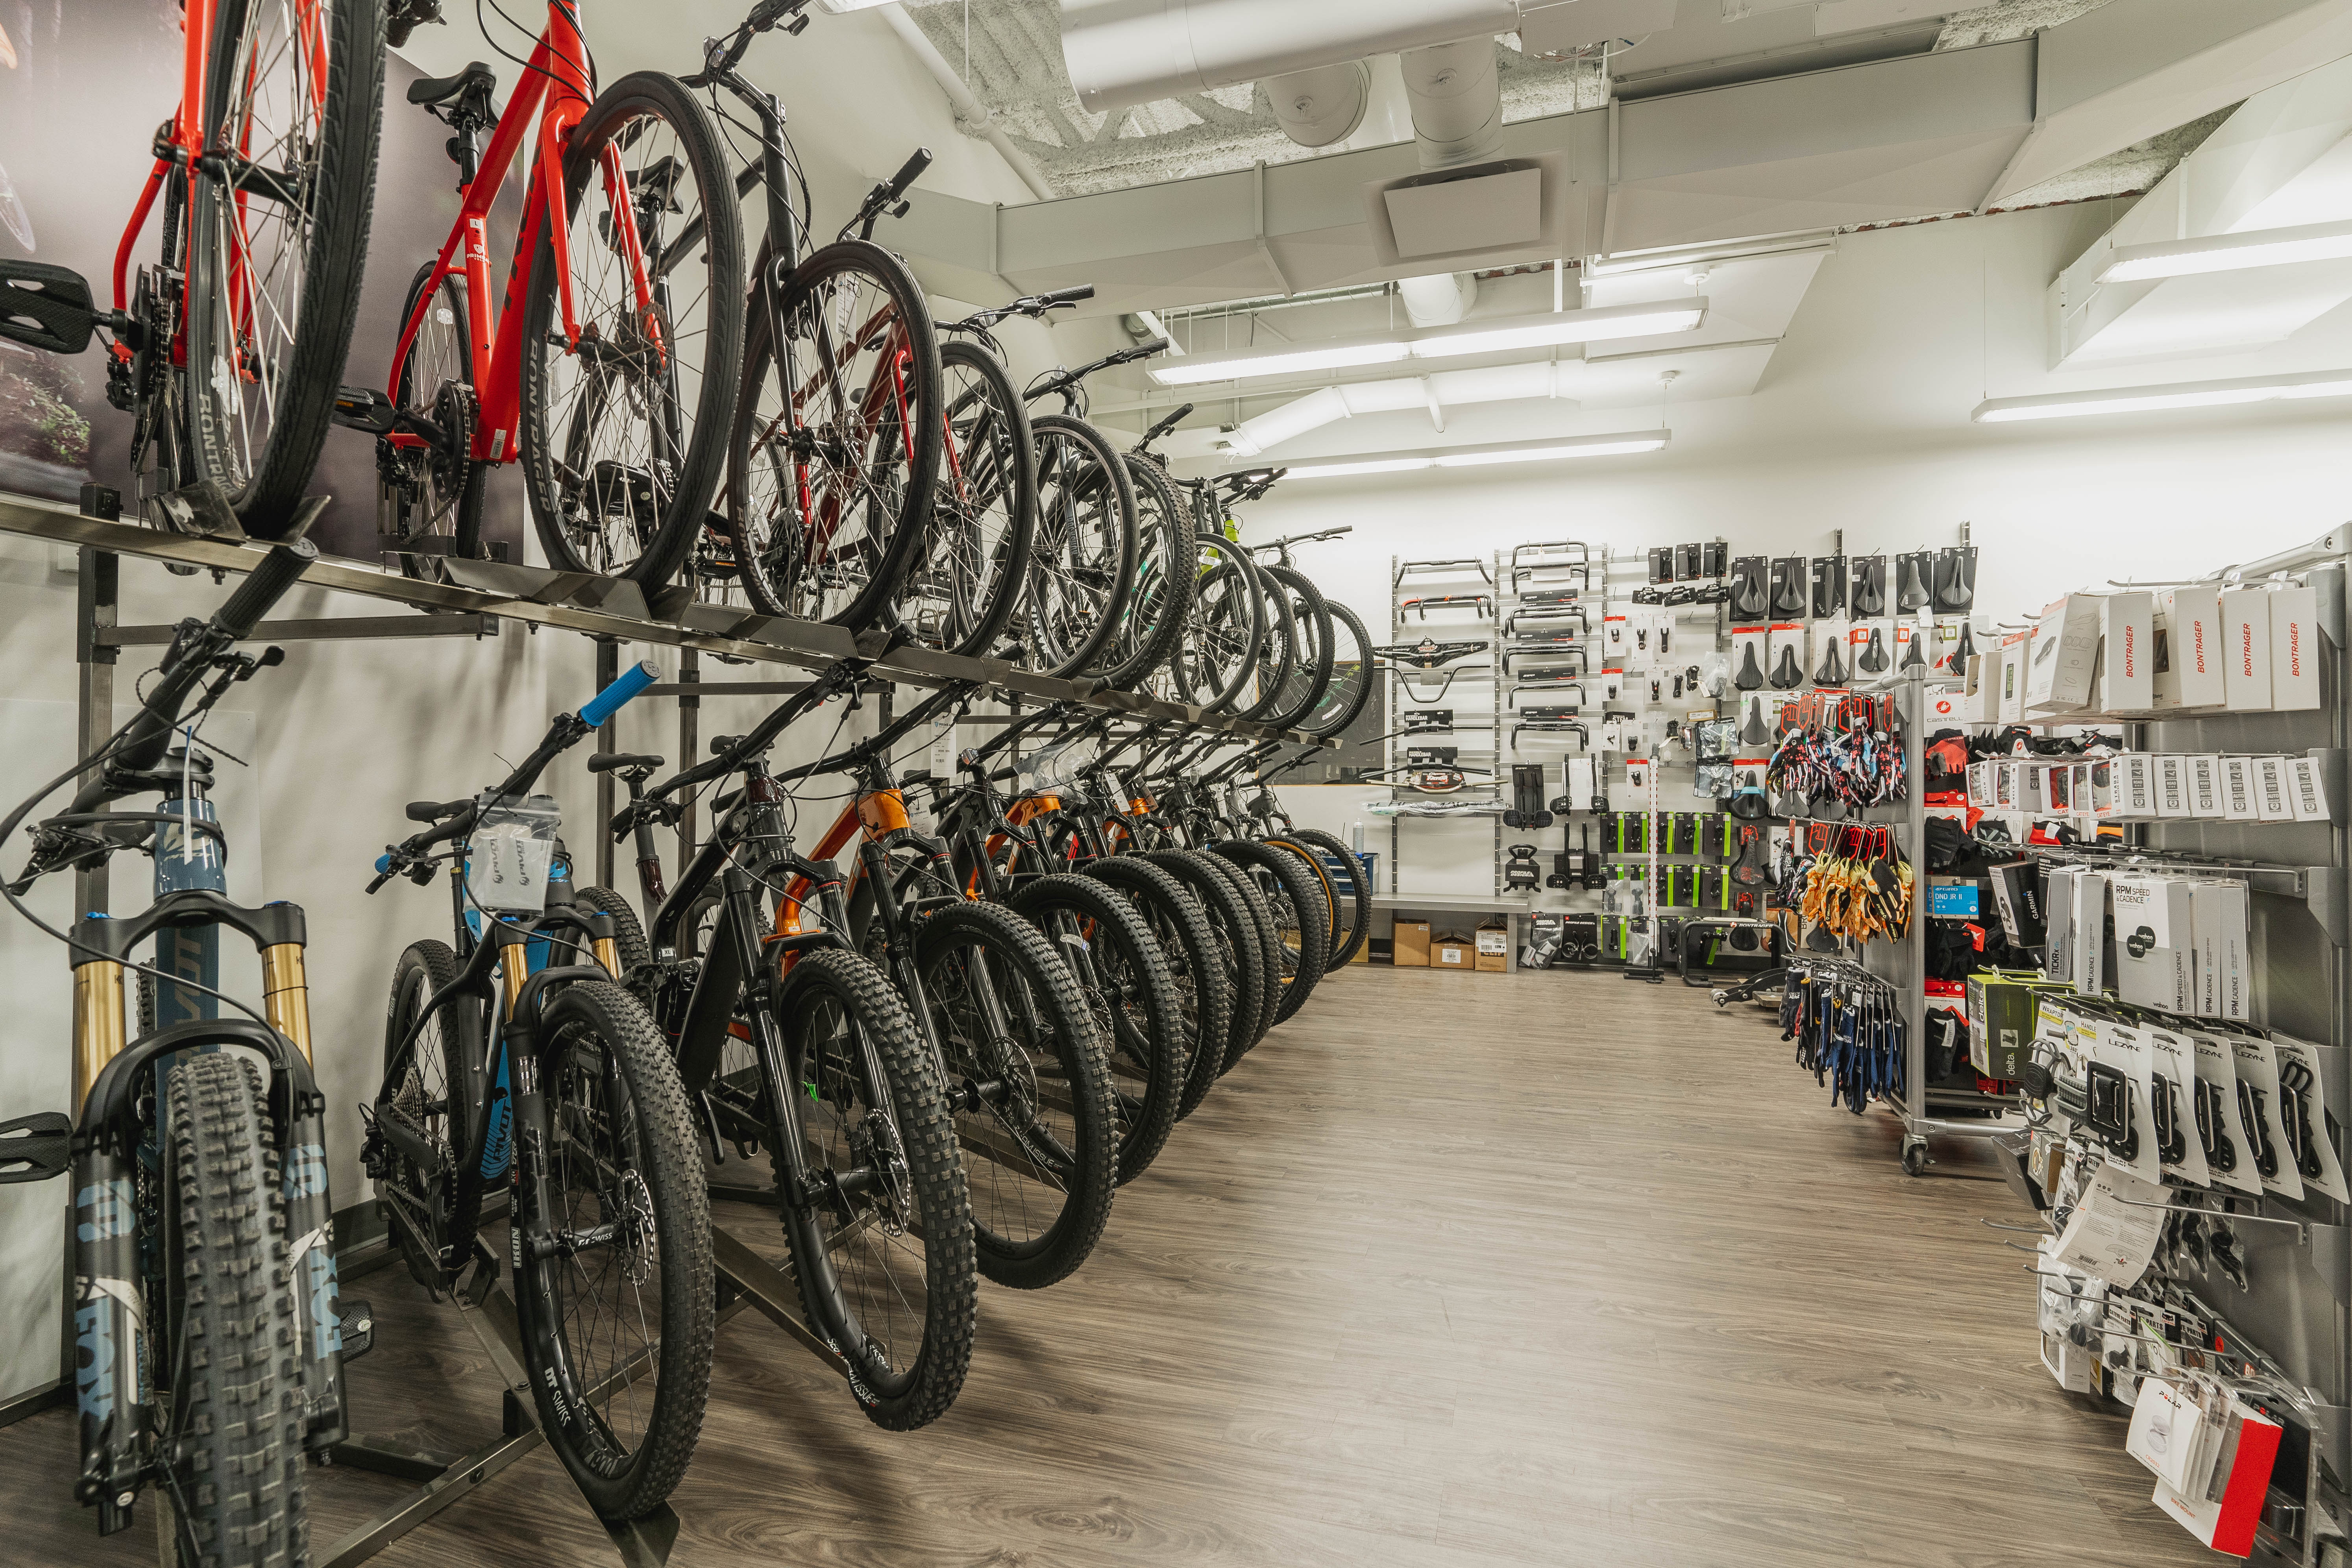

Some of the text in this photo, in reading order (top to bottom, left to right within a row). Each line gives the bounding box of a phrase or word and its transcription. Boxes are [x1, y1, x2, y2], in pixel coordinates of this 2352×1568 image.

[2195, 620, 2204, 673] BONTRAGER
[2116, 886, 2131, 895] RPM
[2027, 891, 2039, 919] GARMIN
[2120, 895, 2144, 904] CADENCE
[2042, 1004, 2064, 1019] WRAPTOR
[2108, 1038, 2141, 1053] LEZYNE
[2152, 1043, 2183, 1057] LEZYNE
[2195, 1046, 2223, 1059] LEZYNE
[2236, 1049, 2266, 1062] LEZYNE
[2283, 1051, 2310, 1066] LEZYNE
[2006, 1054, 2015, 1075] delta
[2146, 1318, 2163, 1331] PARTS
[544, 1366, 571, 1427] DT SWISS
[854, 1383, 875, 1404] ISSUE
[2159, 1390, 2182, 1410] POLAR
[2145, 1454, 2160, 1468] CR2032
[2171, 1497, 2180, 1507] BIKE
[2180, 1504, 2196, 1519] MOUNT
